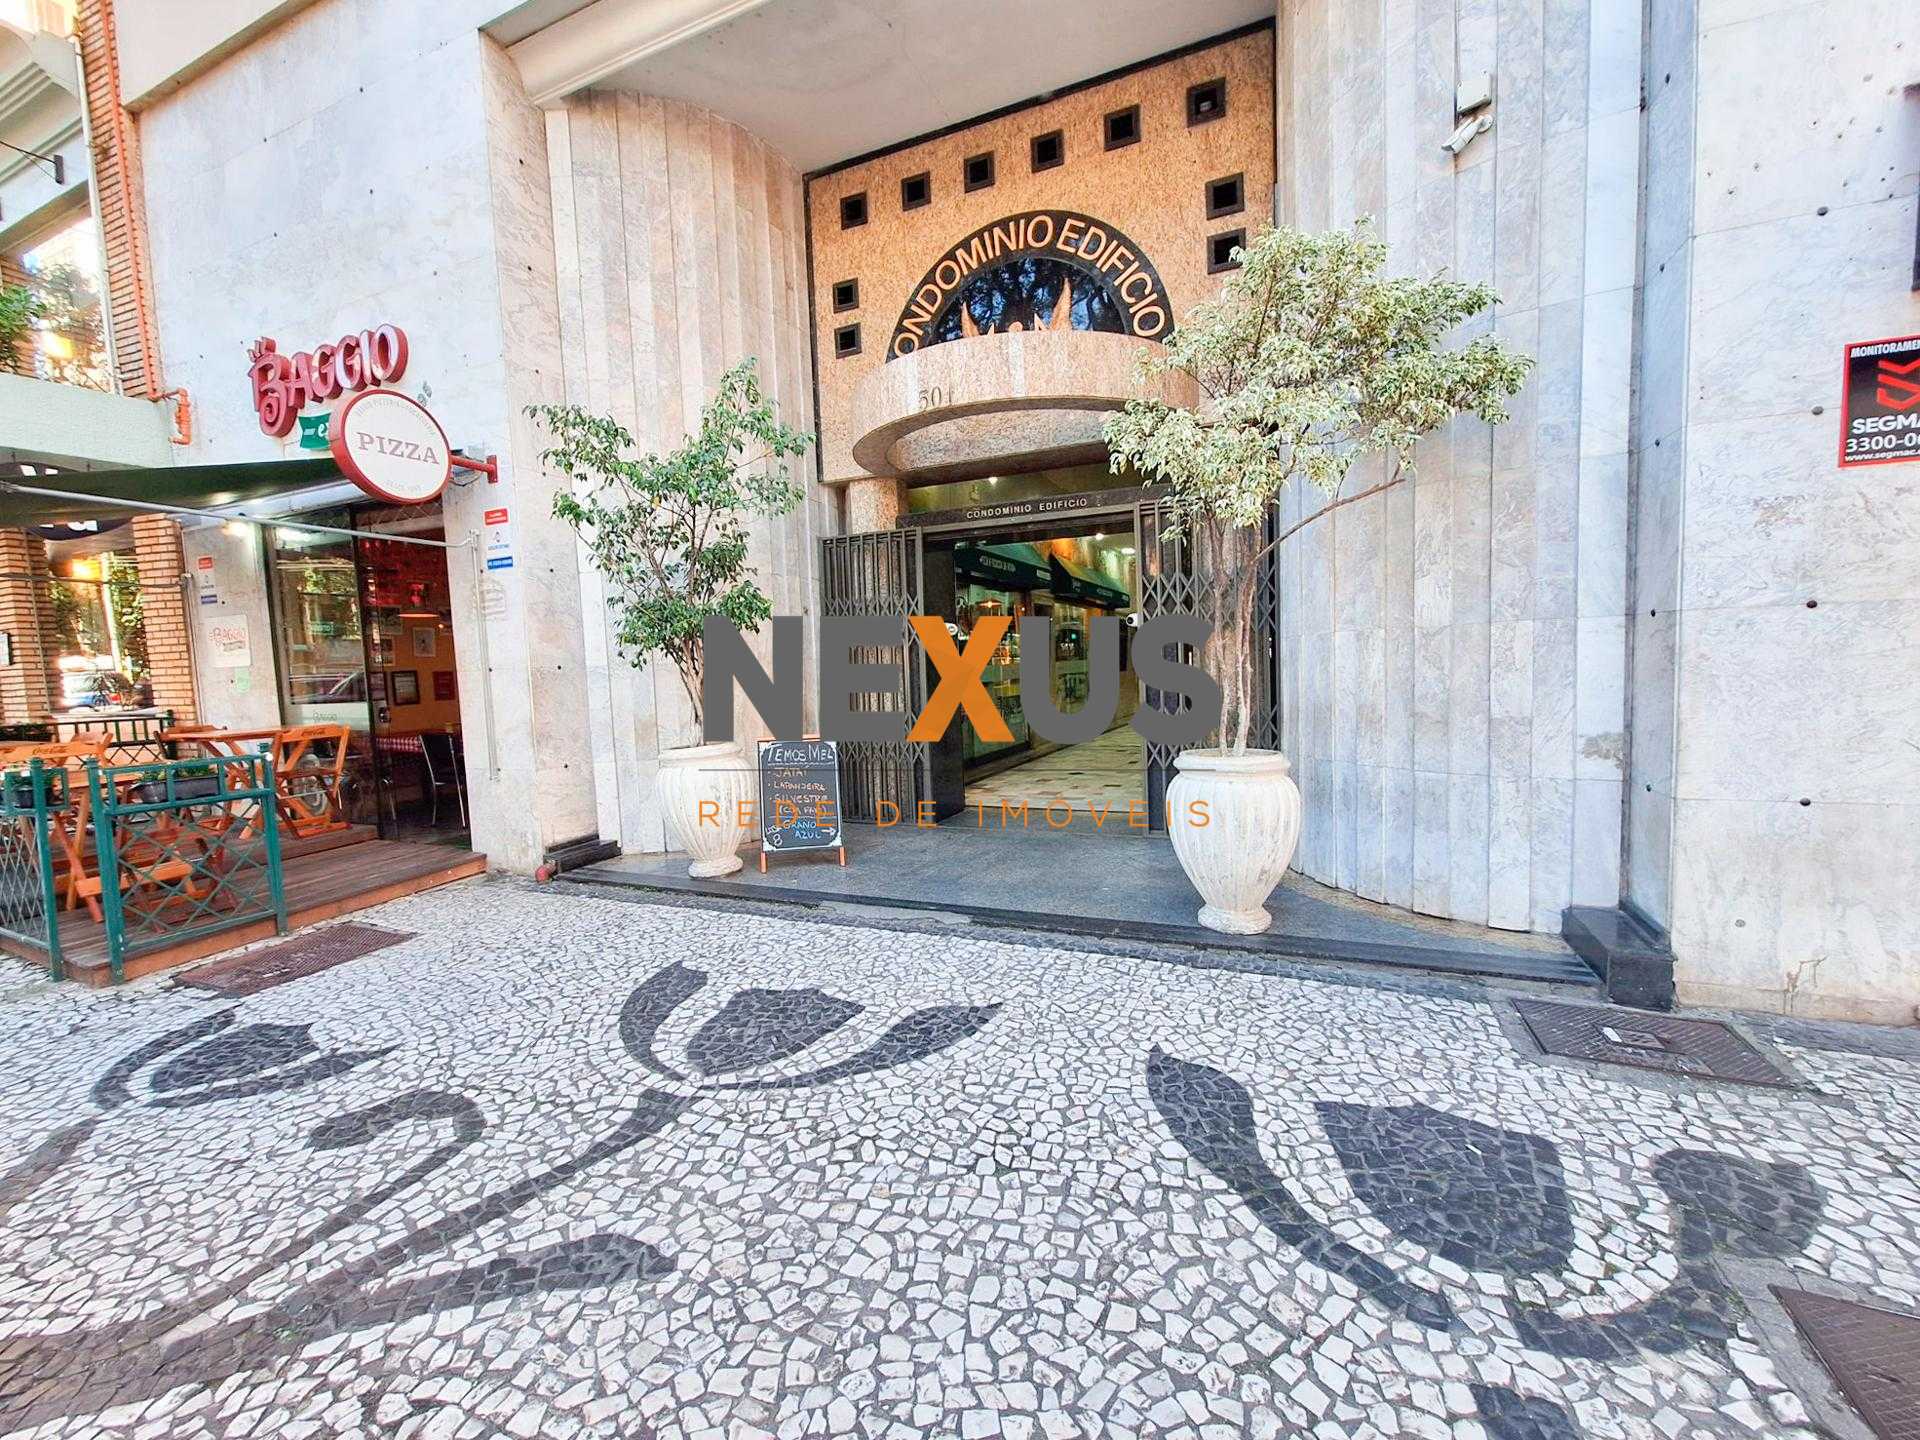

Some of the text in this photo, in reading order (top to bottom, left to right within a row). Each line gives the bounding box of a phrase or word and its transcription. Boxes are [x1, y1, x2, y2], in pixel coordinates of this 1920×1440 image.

[894, 215, 1165, 358] ONDOMINIO EDIFICIO
[247, 323, 409, 438] BAGGIO
[1852, 413, 1920, 434] SEGM
[356, 432, 440, 465] PIZZA
[1039, 498, 1088, 511] EDIFICIO
[768, 744, 834, 762] TEMOS MEL
